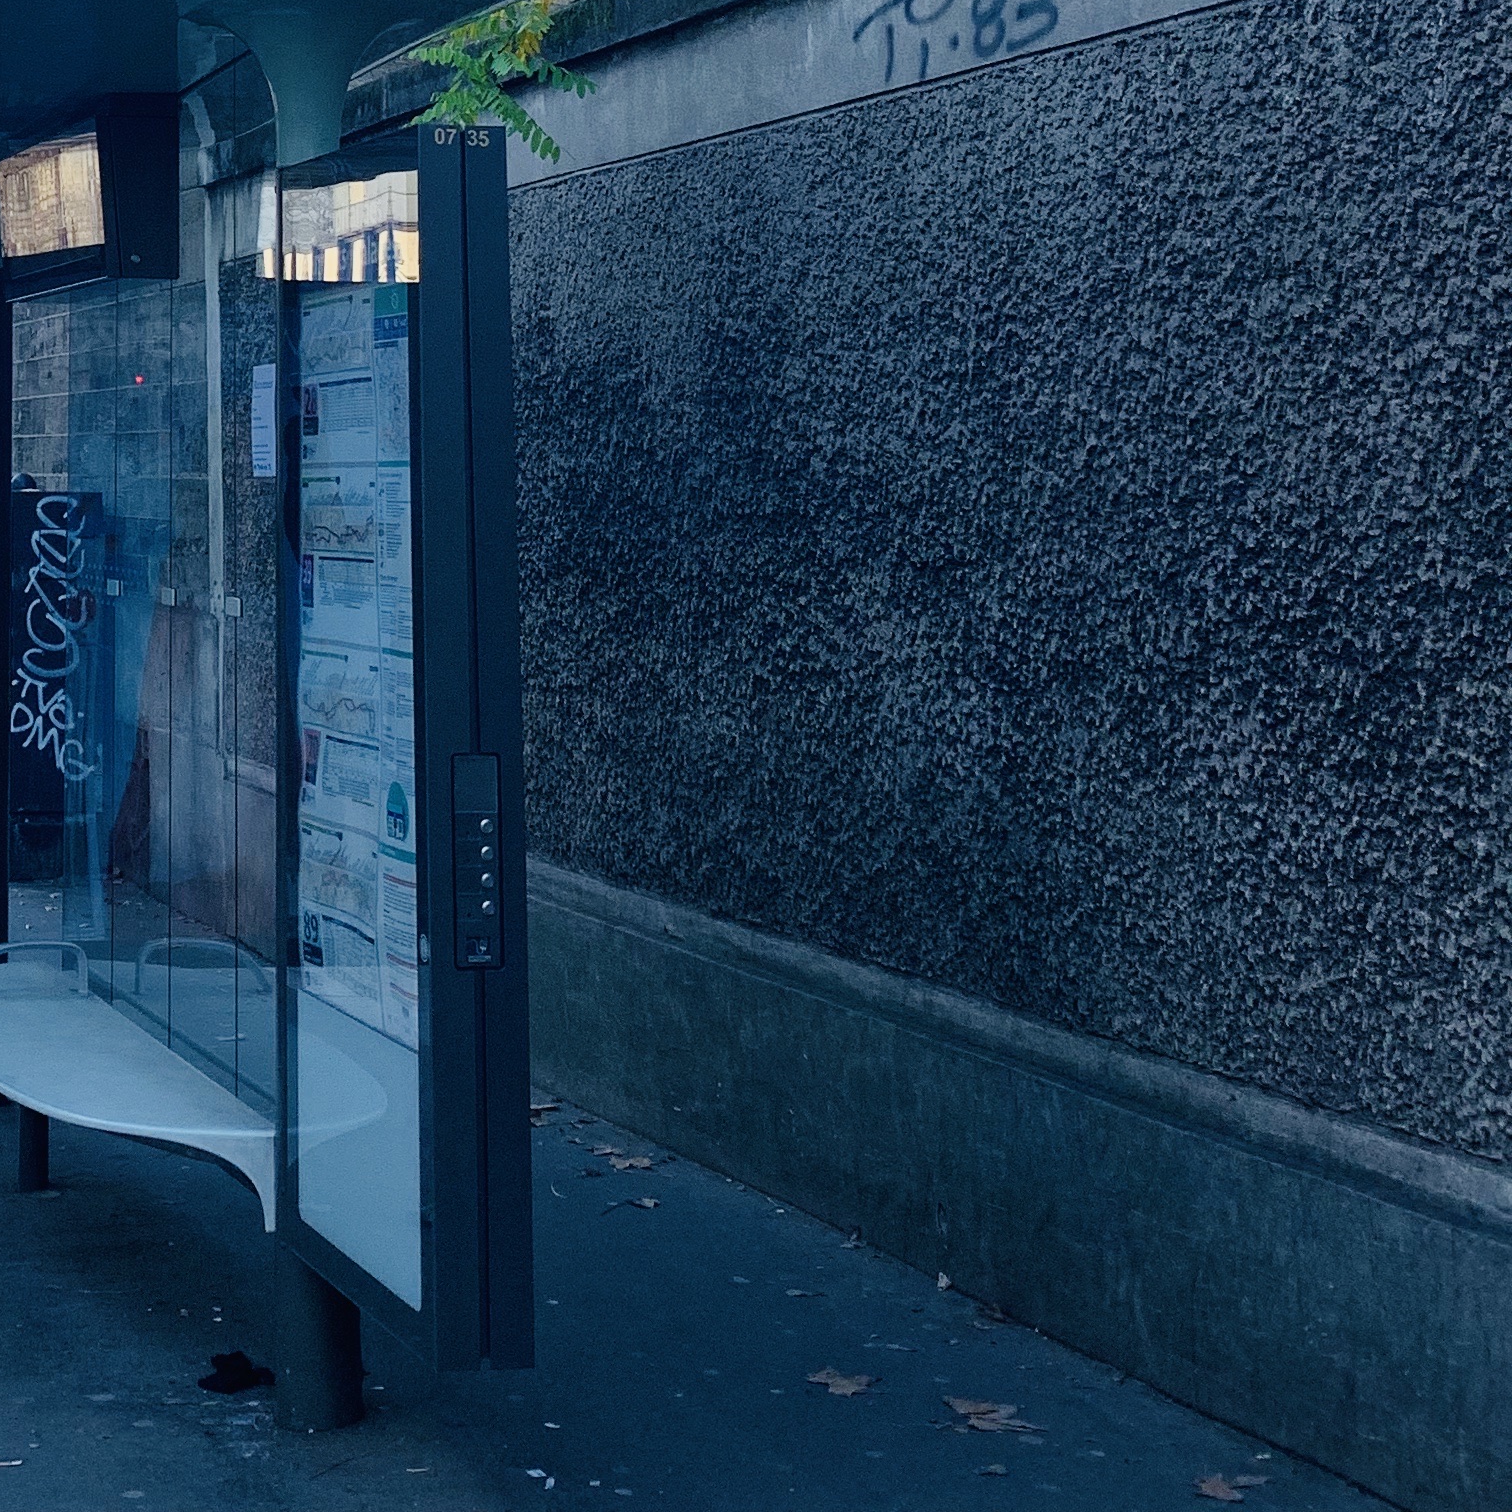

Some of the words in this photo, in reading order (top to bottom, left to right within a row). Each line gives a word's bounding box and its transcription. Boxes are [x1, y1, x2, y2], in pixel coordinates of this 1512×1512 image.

[434, 127, 457, 145] 07
[467, 129, 490, 148] 35
[303, 910, 319, 943] 89
